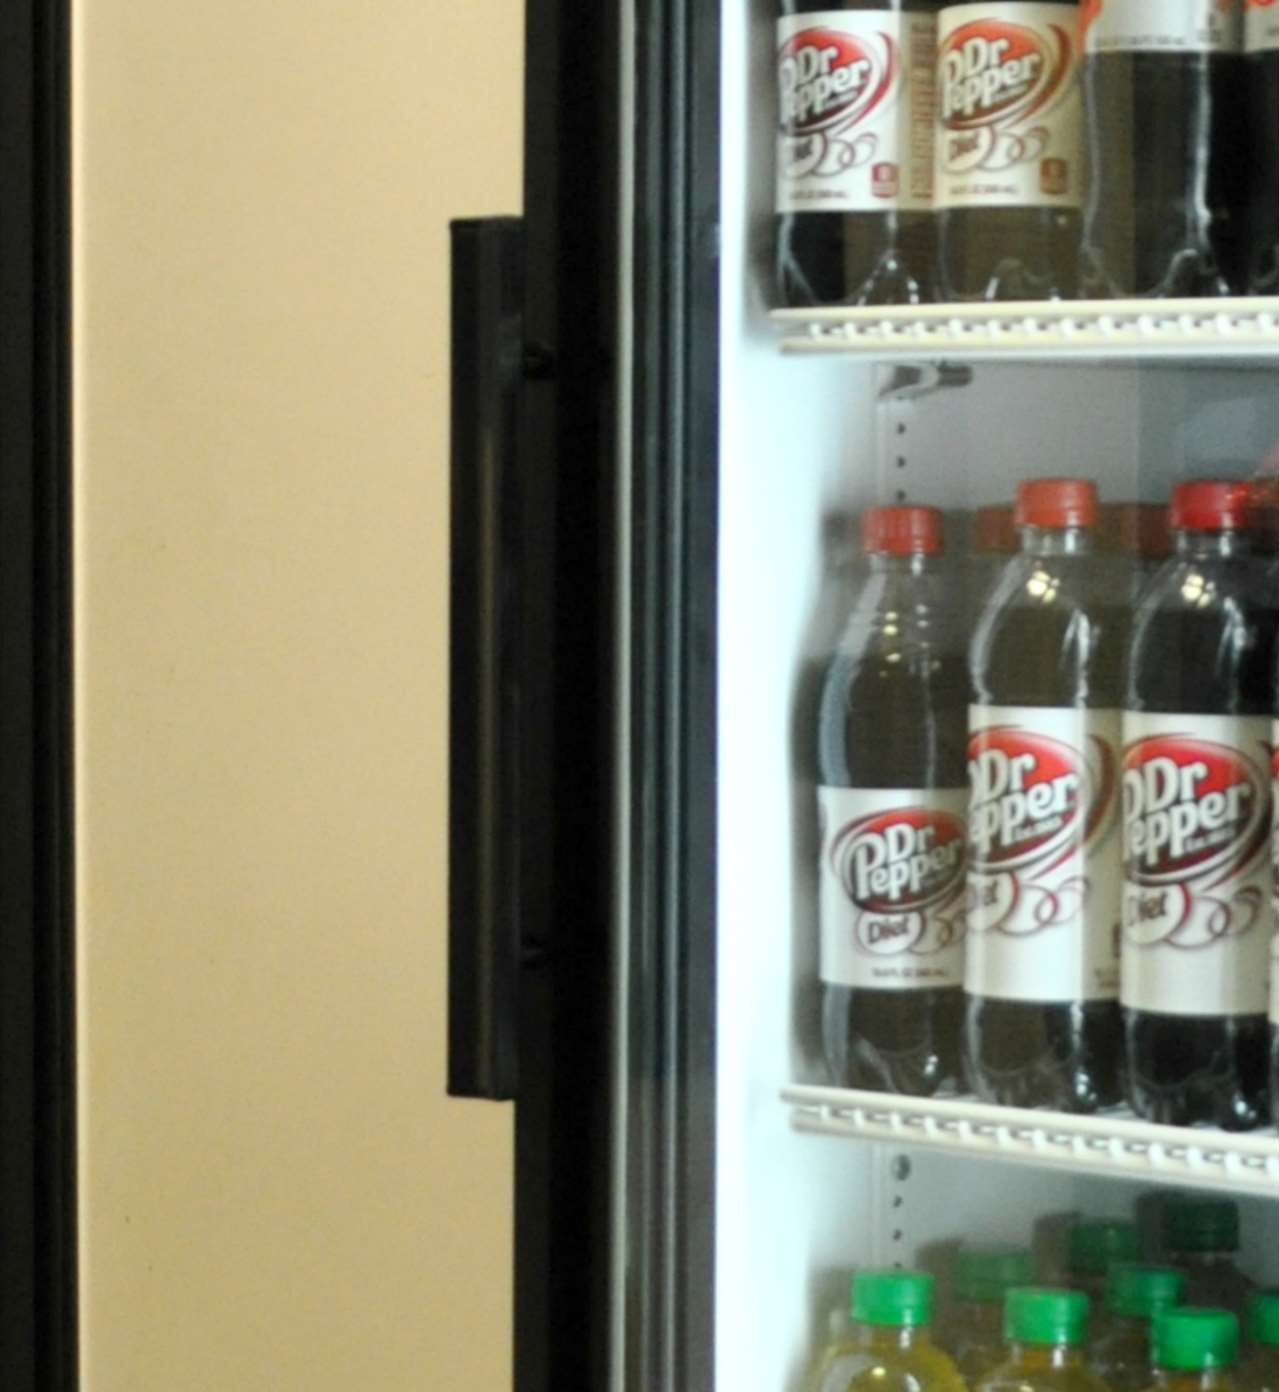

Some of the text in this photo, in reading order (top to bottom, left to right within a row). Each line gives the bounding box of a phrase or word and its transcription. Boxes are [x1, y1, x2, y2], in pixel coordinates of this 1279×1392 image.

[795, 45, 839, 85] Dr
[941, 48, 1041, 120] Pepper
[961, 35, 1010, 76] Dr
[975, 748, 1036, 806] Dr
[1143, 756, 1208, 813] Dr
[844, 832, 962, 900] Pepper
[884, 822, 935, 864] Dr
